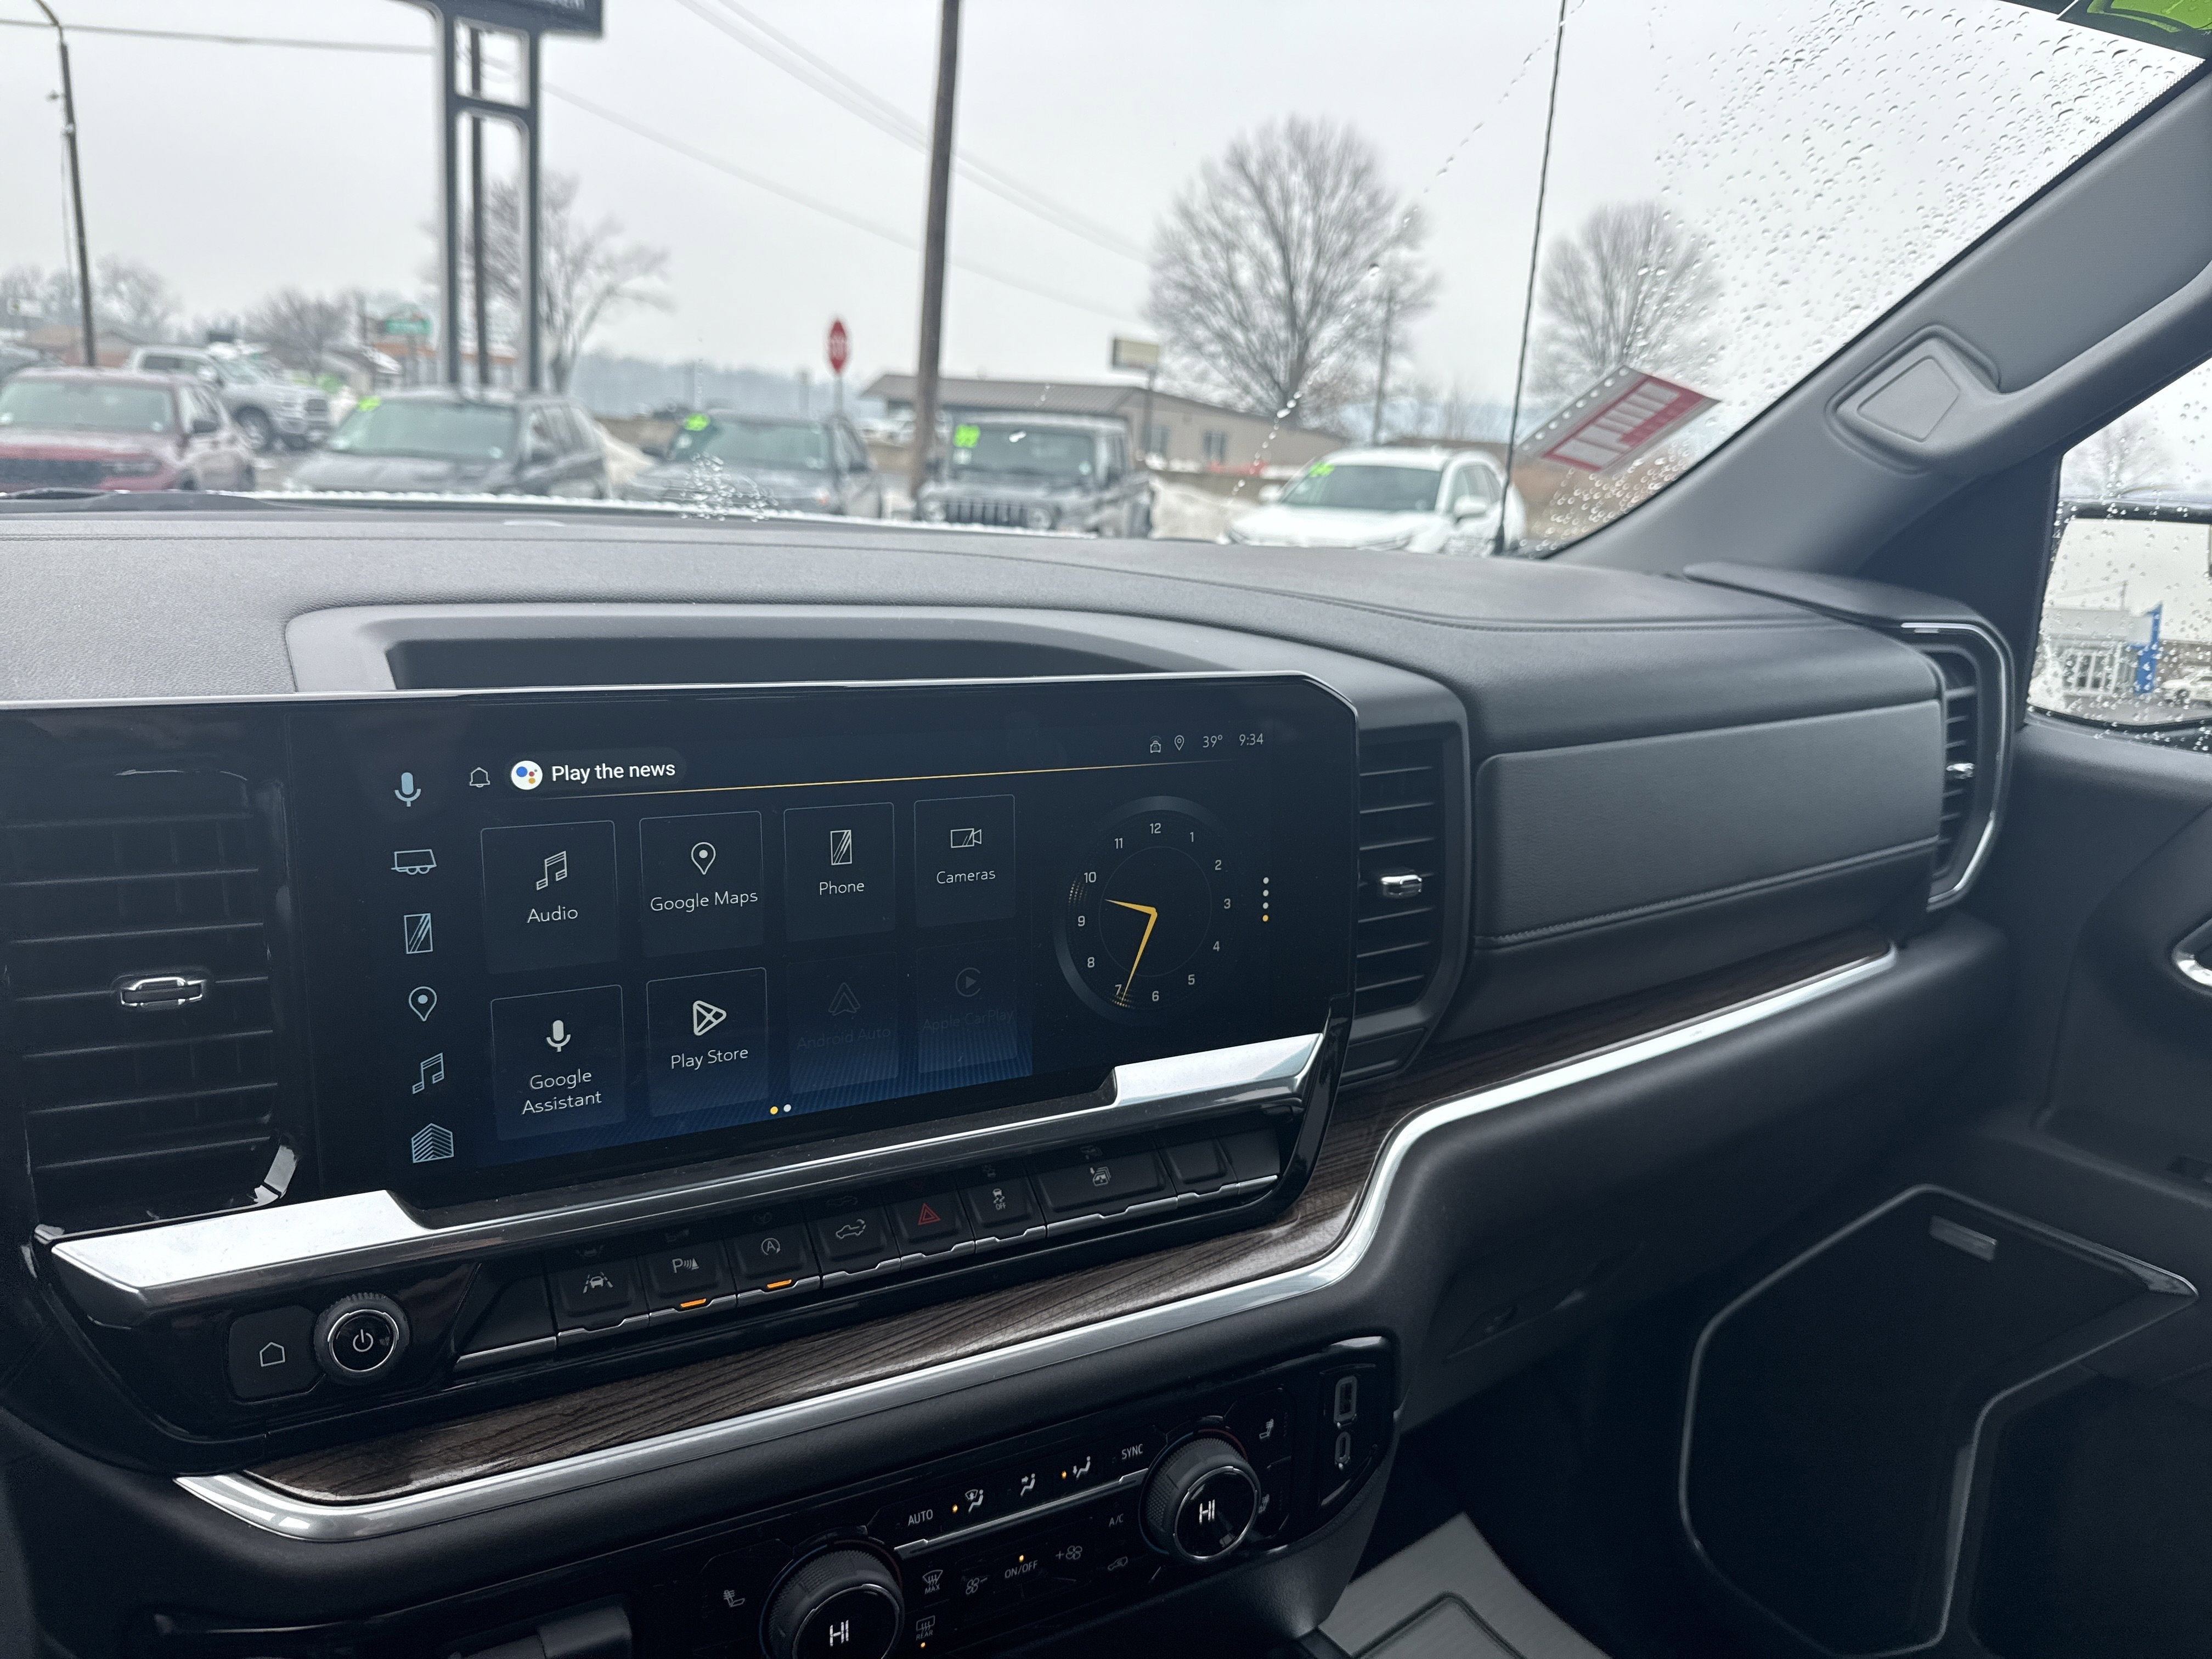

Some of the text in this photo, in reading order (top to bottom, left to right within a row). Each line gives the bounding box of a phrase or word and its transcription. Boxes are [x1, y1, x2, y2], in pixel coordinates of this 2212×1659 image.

[1239, 733, 1264, 746] 9:34
[552, 763, 675, 784] Play the news
[1149, 822, 1161, 834] 12
[1114, 837, 1124, 849] 11
[1189, 831, 1194, 843] 1
[1215, 859, 1222, 871] 2
[936, 870, 996, 884] Cameras
[1084, 871, 1097, 884] 10
[820, 880, 865, 895] Phone
[650, 890, 758, 912] Google Maps
[1223, 898, 1231, 909] 3
[527, 905, 578, 923] Audio
[1077, 915, 1086, 927] 9
[1212, 941, 1221, 952] 4
[1087, 956, 1095, 968] 8
[1188, 974, 1195, 985] 5
[1115, 984, 1122, 995] 7
[1152, 990, 1160, 1002] 6
[922, 1009, 1014, 1033] Apple CarPlay
[797, 1028, 891, 1049] Android Auto
[671, 1048, 748, 1070] Play Store
[530, 1068, 592, 1090] Google
[522, 1091, 602, 1115] Assistant
[996, 1202, 1006, 1210] OFF
[1121, 1443, 1143, 1460] SYNC
[907, 1509, 933, 1526] AUTO
[1199, 1499, 1215, 1525] HI
[1109, 1513, 1124, 1527] A/C
[1005, 1560, 1038, 1578] ON/OFF
[924, 1583, 940, 1594] MAX
[830, 1620, 849, 1646] HI
[916, 1629, 933, 1640] REAR
